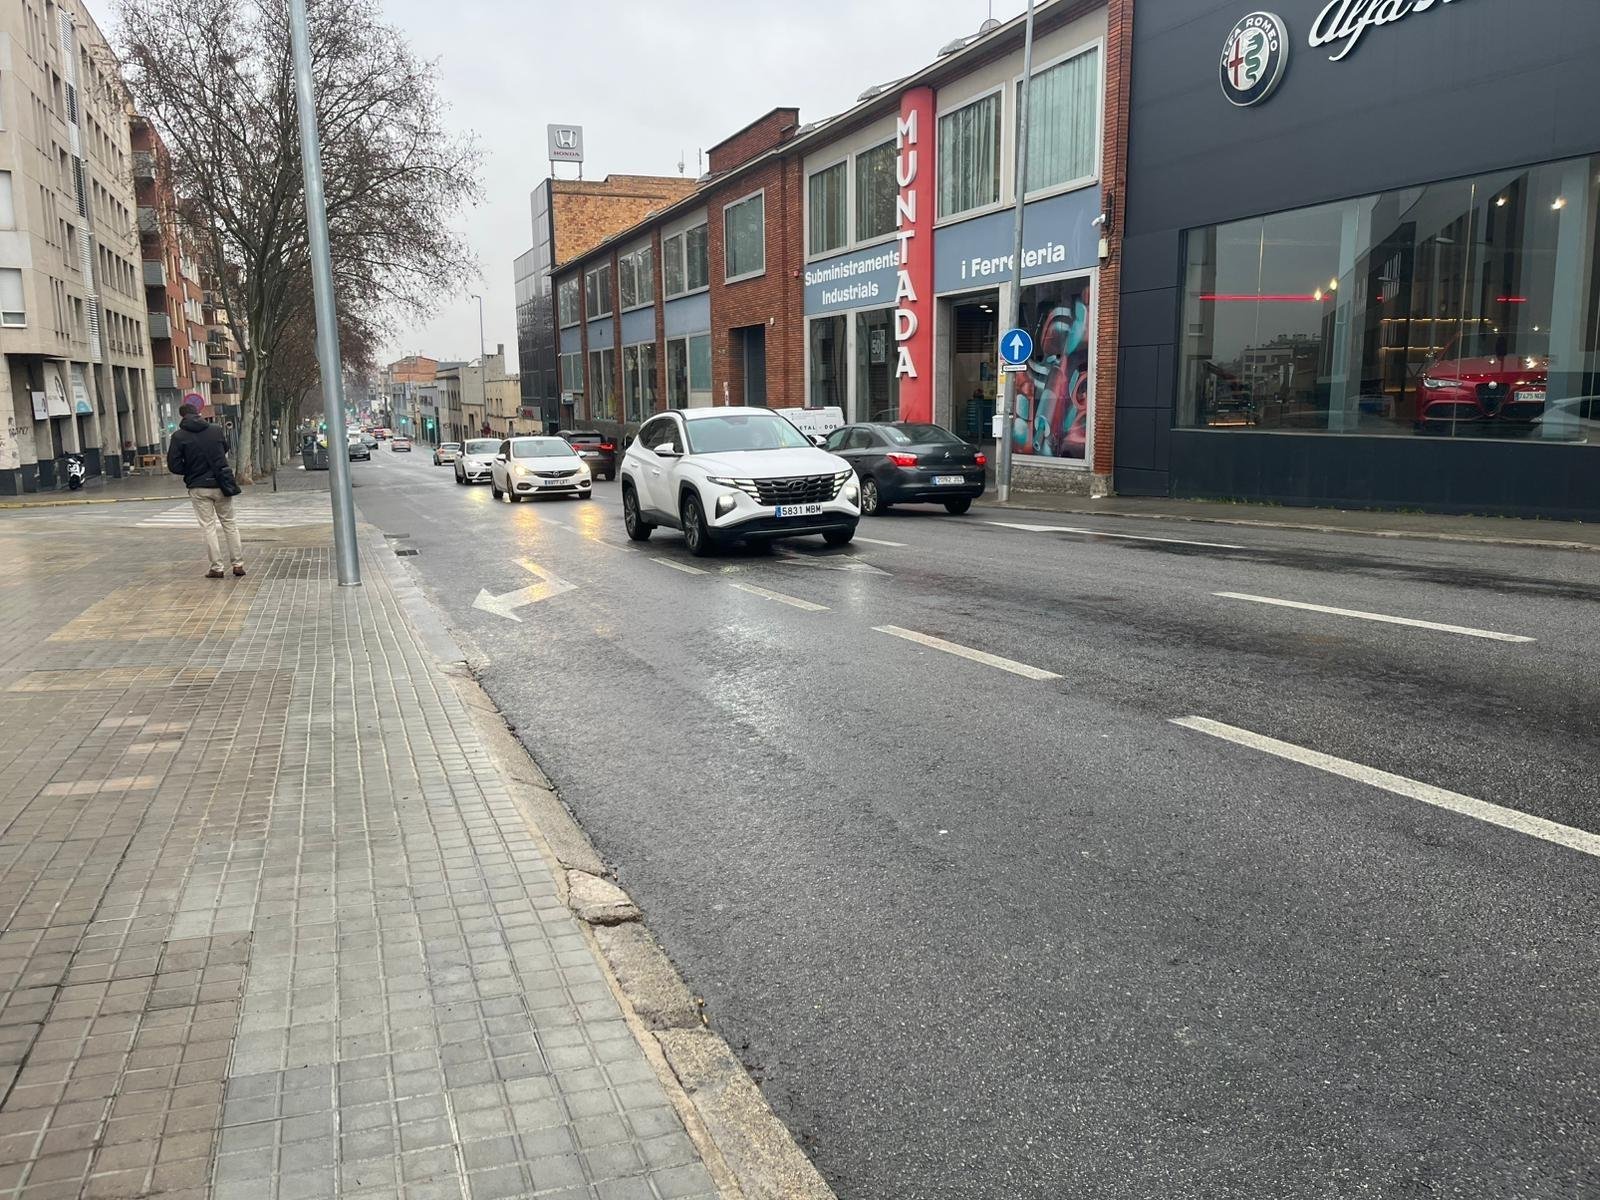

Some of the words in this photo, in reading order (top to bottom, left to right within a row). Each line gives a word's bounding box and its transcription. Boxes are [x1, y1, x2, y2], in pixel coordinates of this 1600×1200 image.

[1246, 17, 1278, 52] ROMEO
[553, 149, 581, 157] HONDA
[895, 109, 918, 379] MUNTADA
[805, 250, 900, 287] Subministraments
[961, 260, 966, 280] i
[822, 281, 879, 305] Industrials
[782, 506, 803, 516] 5831
[805, 504, 821, 514] MBM
